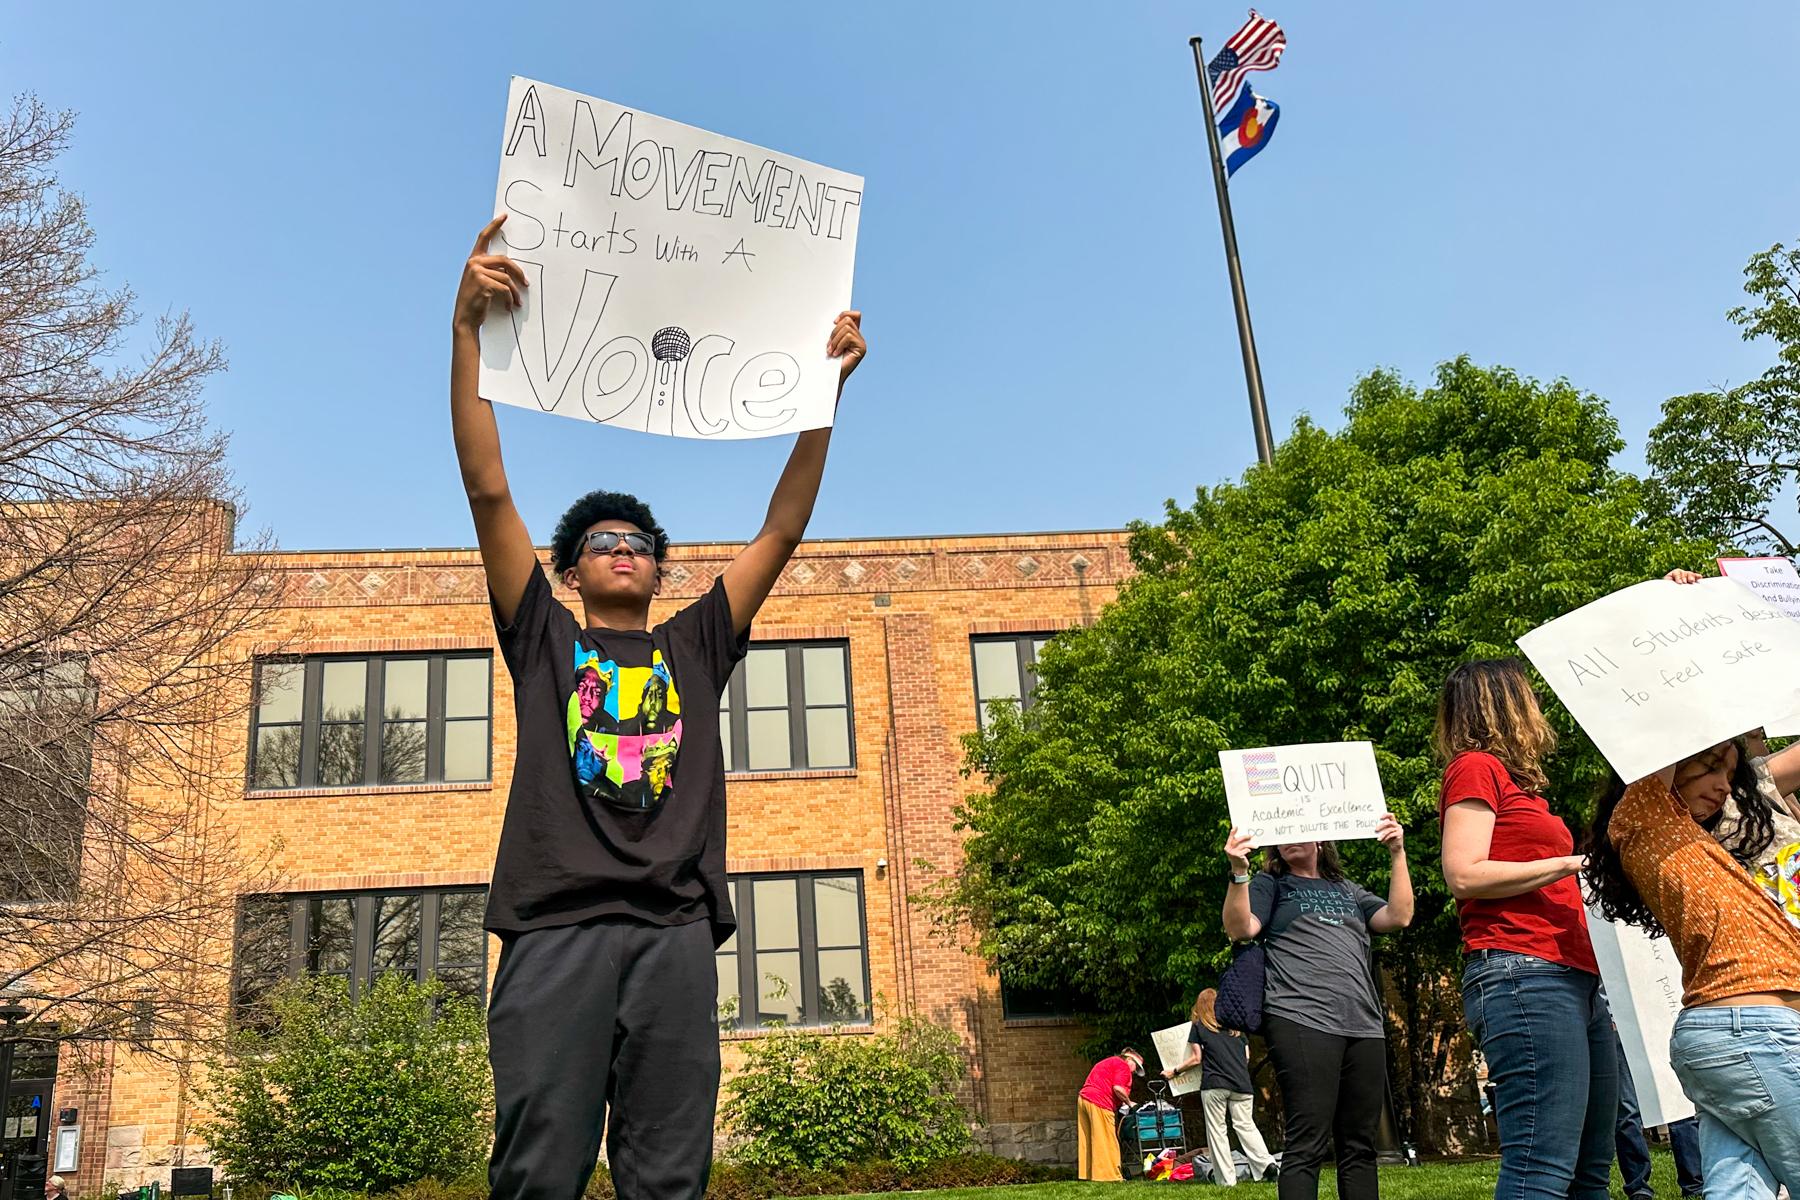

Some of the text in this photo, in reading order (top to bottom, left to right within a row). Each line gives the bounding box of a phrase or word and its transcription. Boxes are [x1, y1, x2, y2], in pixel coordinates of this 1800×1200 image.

[506, 84, 861, 240] A MOVEMENT
[501, 180, 638, 254] Starts
[722, 238, 756, 272] A
[1763, 566, 1784, 575] Take
[1568, 646, 1620, 686] All
[1632, 612, 1734, 656] Students
[1621, 687, 1650, 706] to
[1660, 660, 1704, 688] feel
[1242, 752, 1346, 796] EQUITY
[1248, 828, 1264, 837] DO
[1275, 825, 1295, 836] NOT
[1300, 822, 1329, 833] DILUTE
[1334, 820, 1350, 830] THE
[1252, 801, 1374, 822] Academic Excellence
[1300, 902, 1355, 916] PARTY
